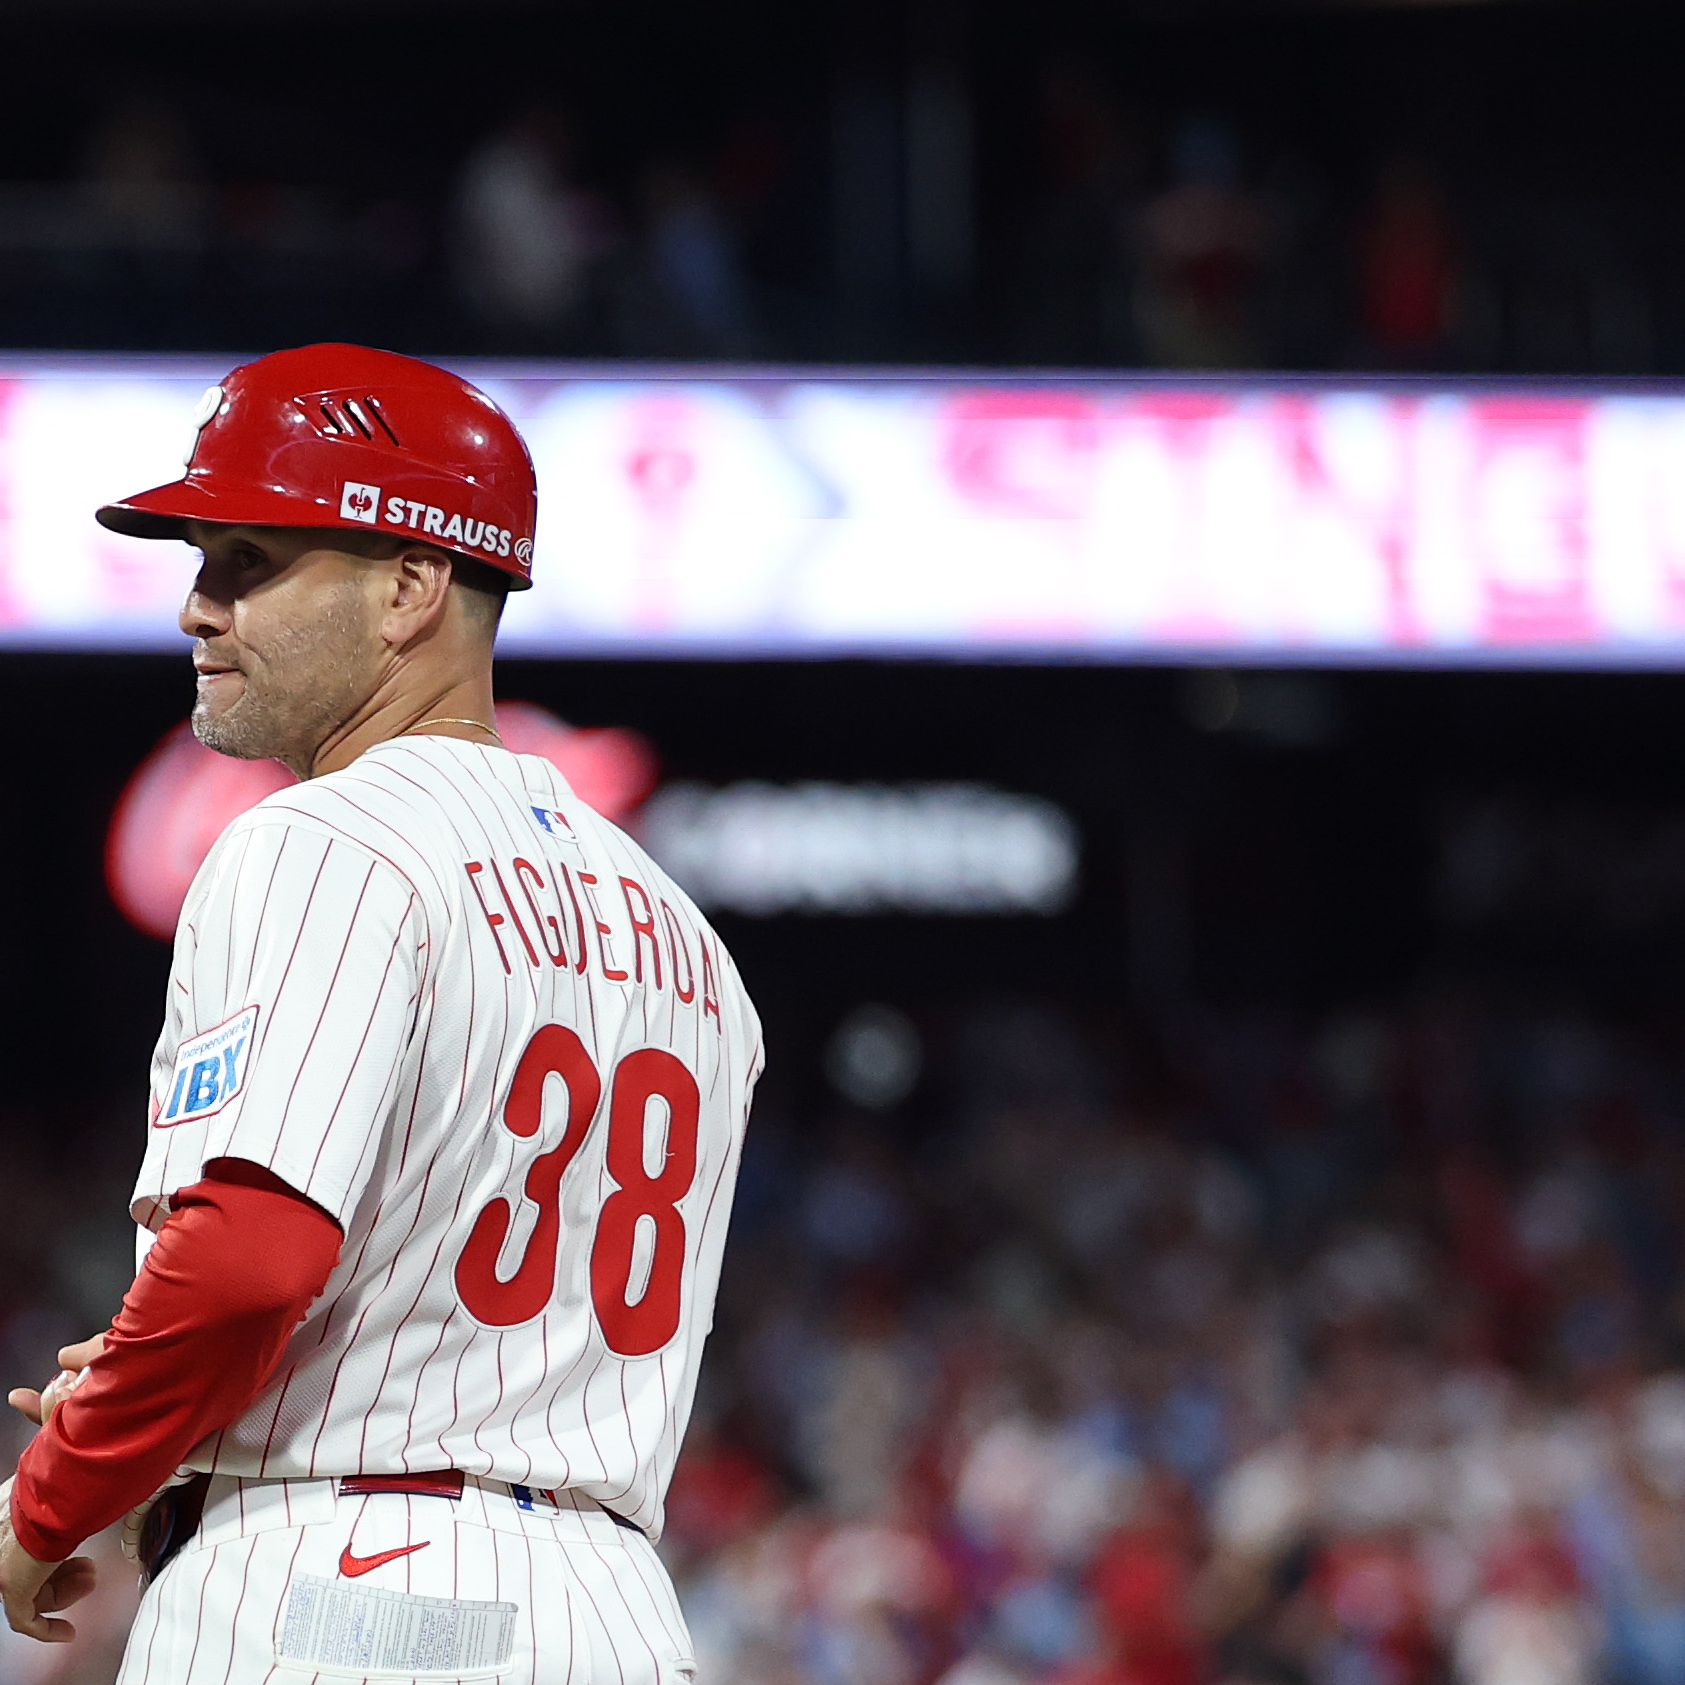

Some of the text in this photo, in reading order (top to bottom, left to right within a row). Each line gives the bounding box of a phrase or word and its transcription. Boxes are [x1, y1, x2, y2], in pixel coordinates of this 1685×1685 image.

[384, 497, 512, 557] STRAUSS
[165, 1036, 247, 1119] IBX
[455, 1023, 700, 1357] 38
